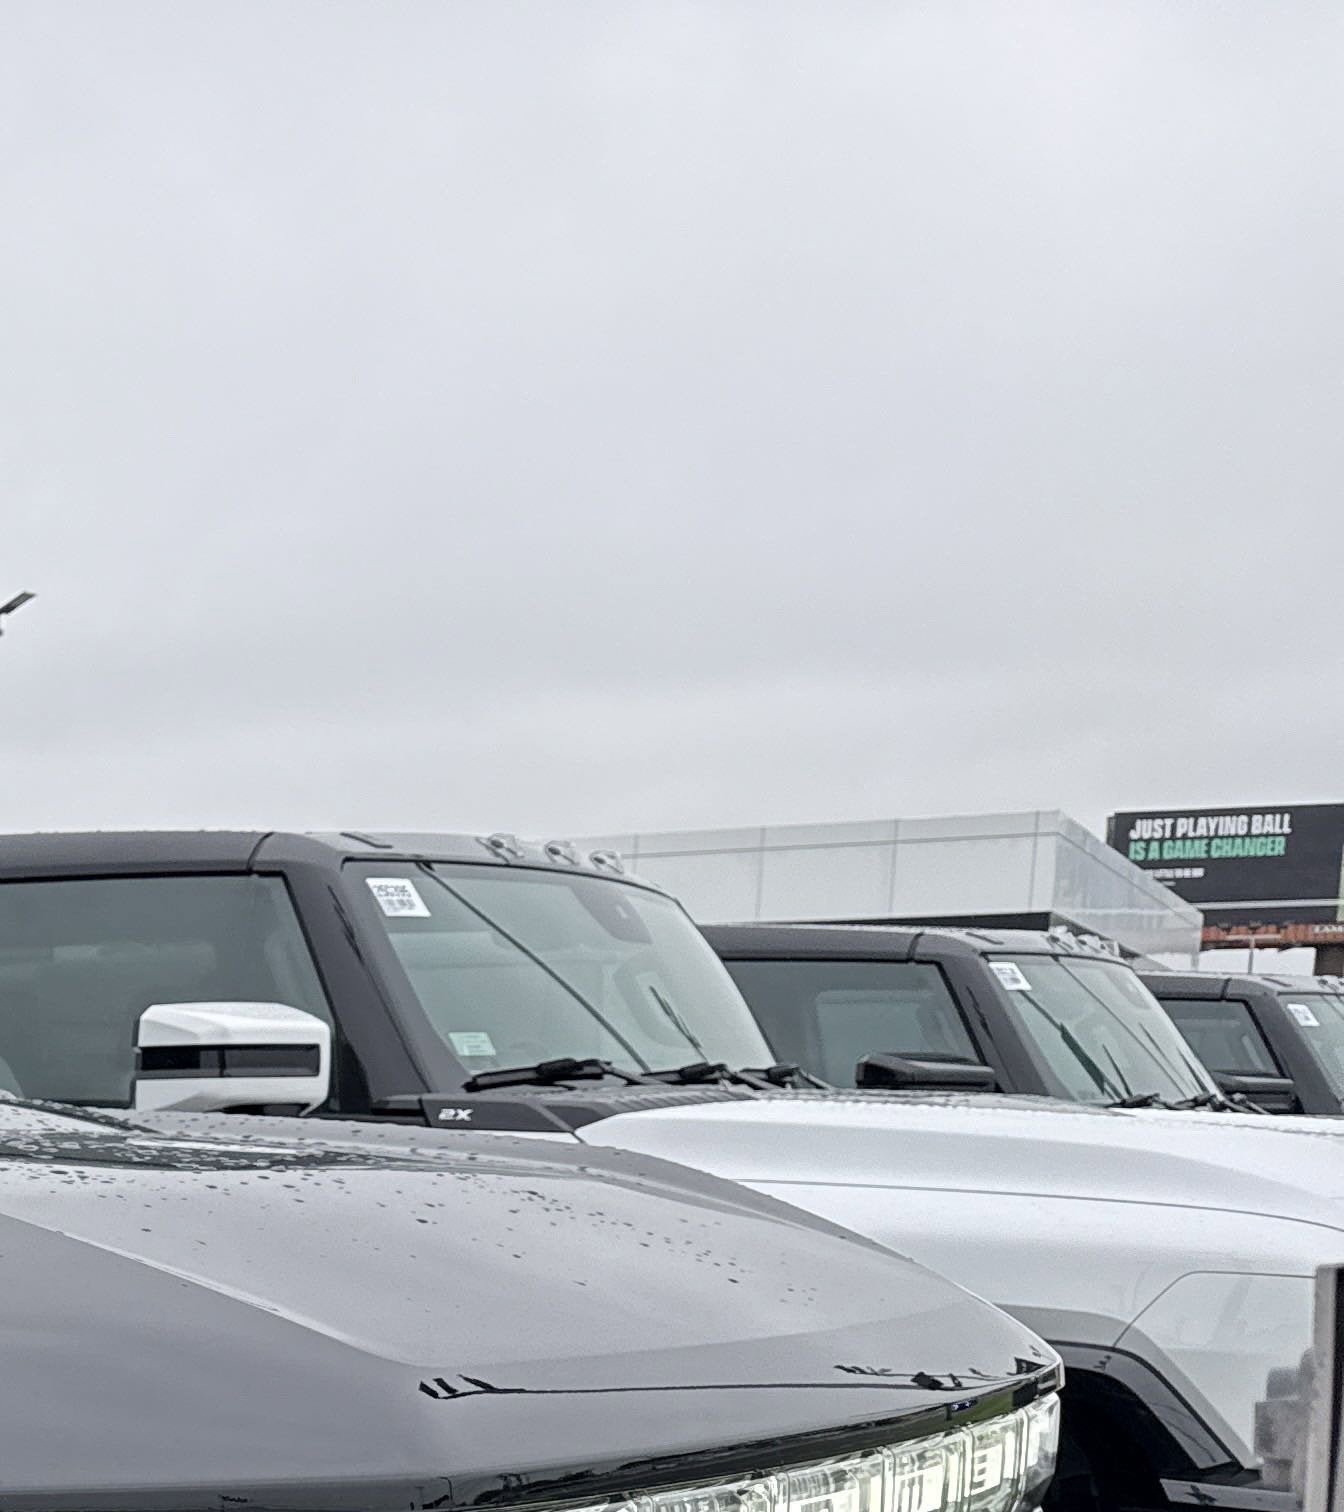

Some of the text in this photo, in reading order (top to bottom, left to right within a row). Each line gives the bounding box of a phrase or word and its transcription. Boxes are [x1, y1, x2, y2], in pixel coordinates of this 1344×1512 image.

[1129, 812, 1293, 840] JUST PLAYING BALL
[1129, 835, 1286, 861] IS A GAME CHANGER
